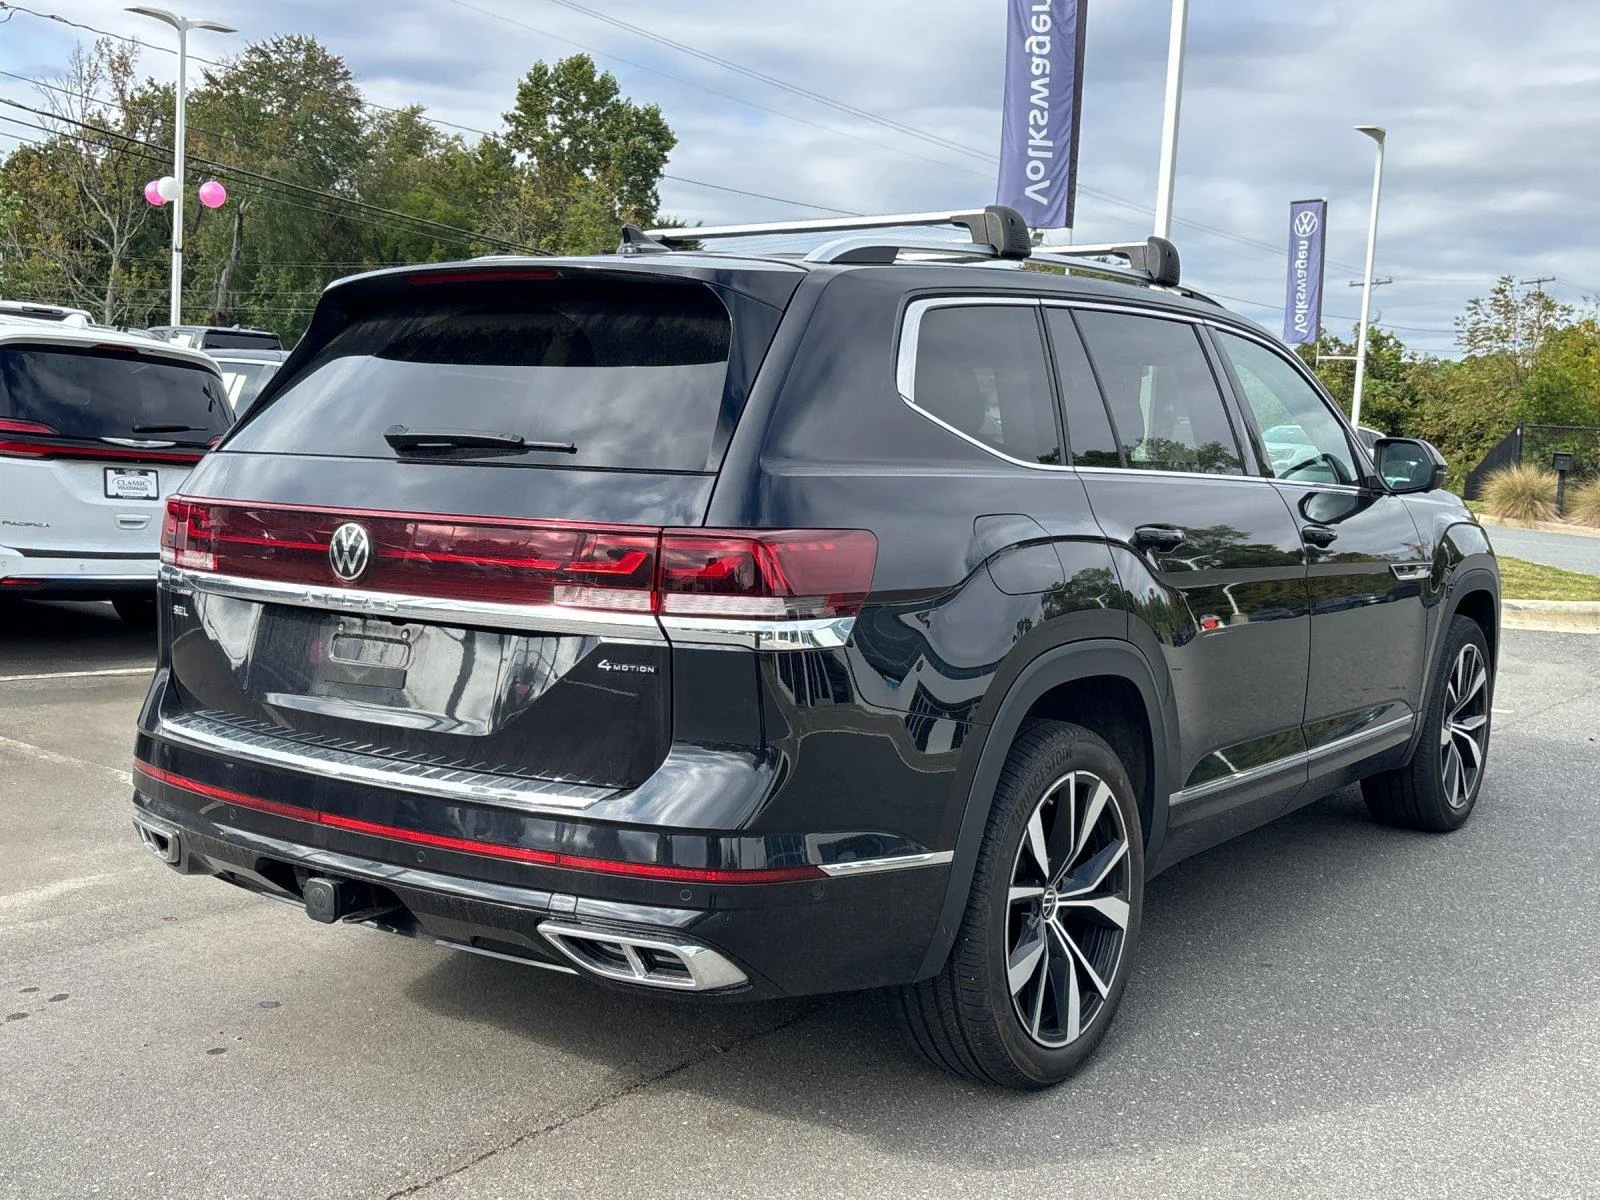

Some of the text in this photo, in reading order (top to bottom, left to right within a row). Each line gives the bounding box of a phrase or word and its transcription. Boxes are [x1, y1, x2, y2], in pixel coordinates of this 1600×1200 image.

[117, 479, 148, 487] CLASSIC
[301, 590, 399, 612] ATLAS
[173, 604, 189, 617] SEL
